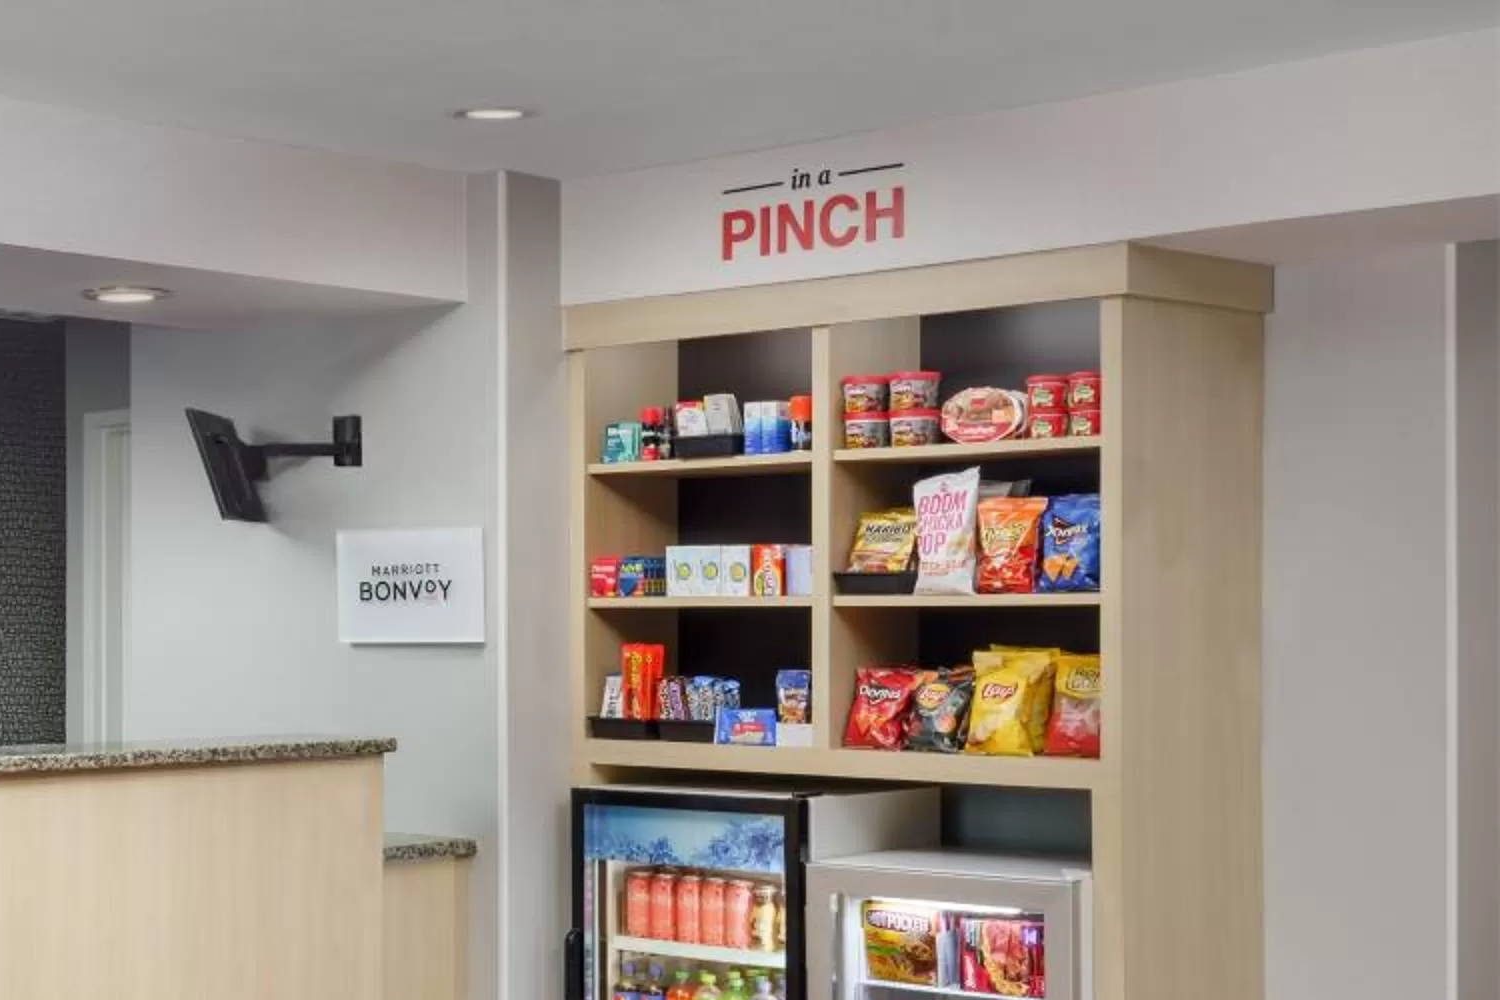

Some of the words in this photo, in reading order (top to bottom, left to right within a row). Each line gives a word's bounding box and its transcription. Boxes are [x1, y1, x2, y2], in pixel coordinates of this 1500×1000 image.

[790, 167, 811, 190] in
[817, 169, 832, 187] a
[721, 186, 905, 261] PINCH
[918, 489, 968, 515] BOOM
[371, 563, 441, 577] MARRIOTT
[358, 579, 452, 602] BONVOY
